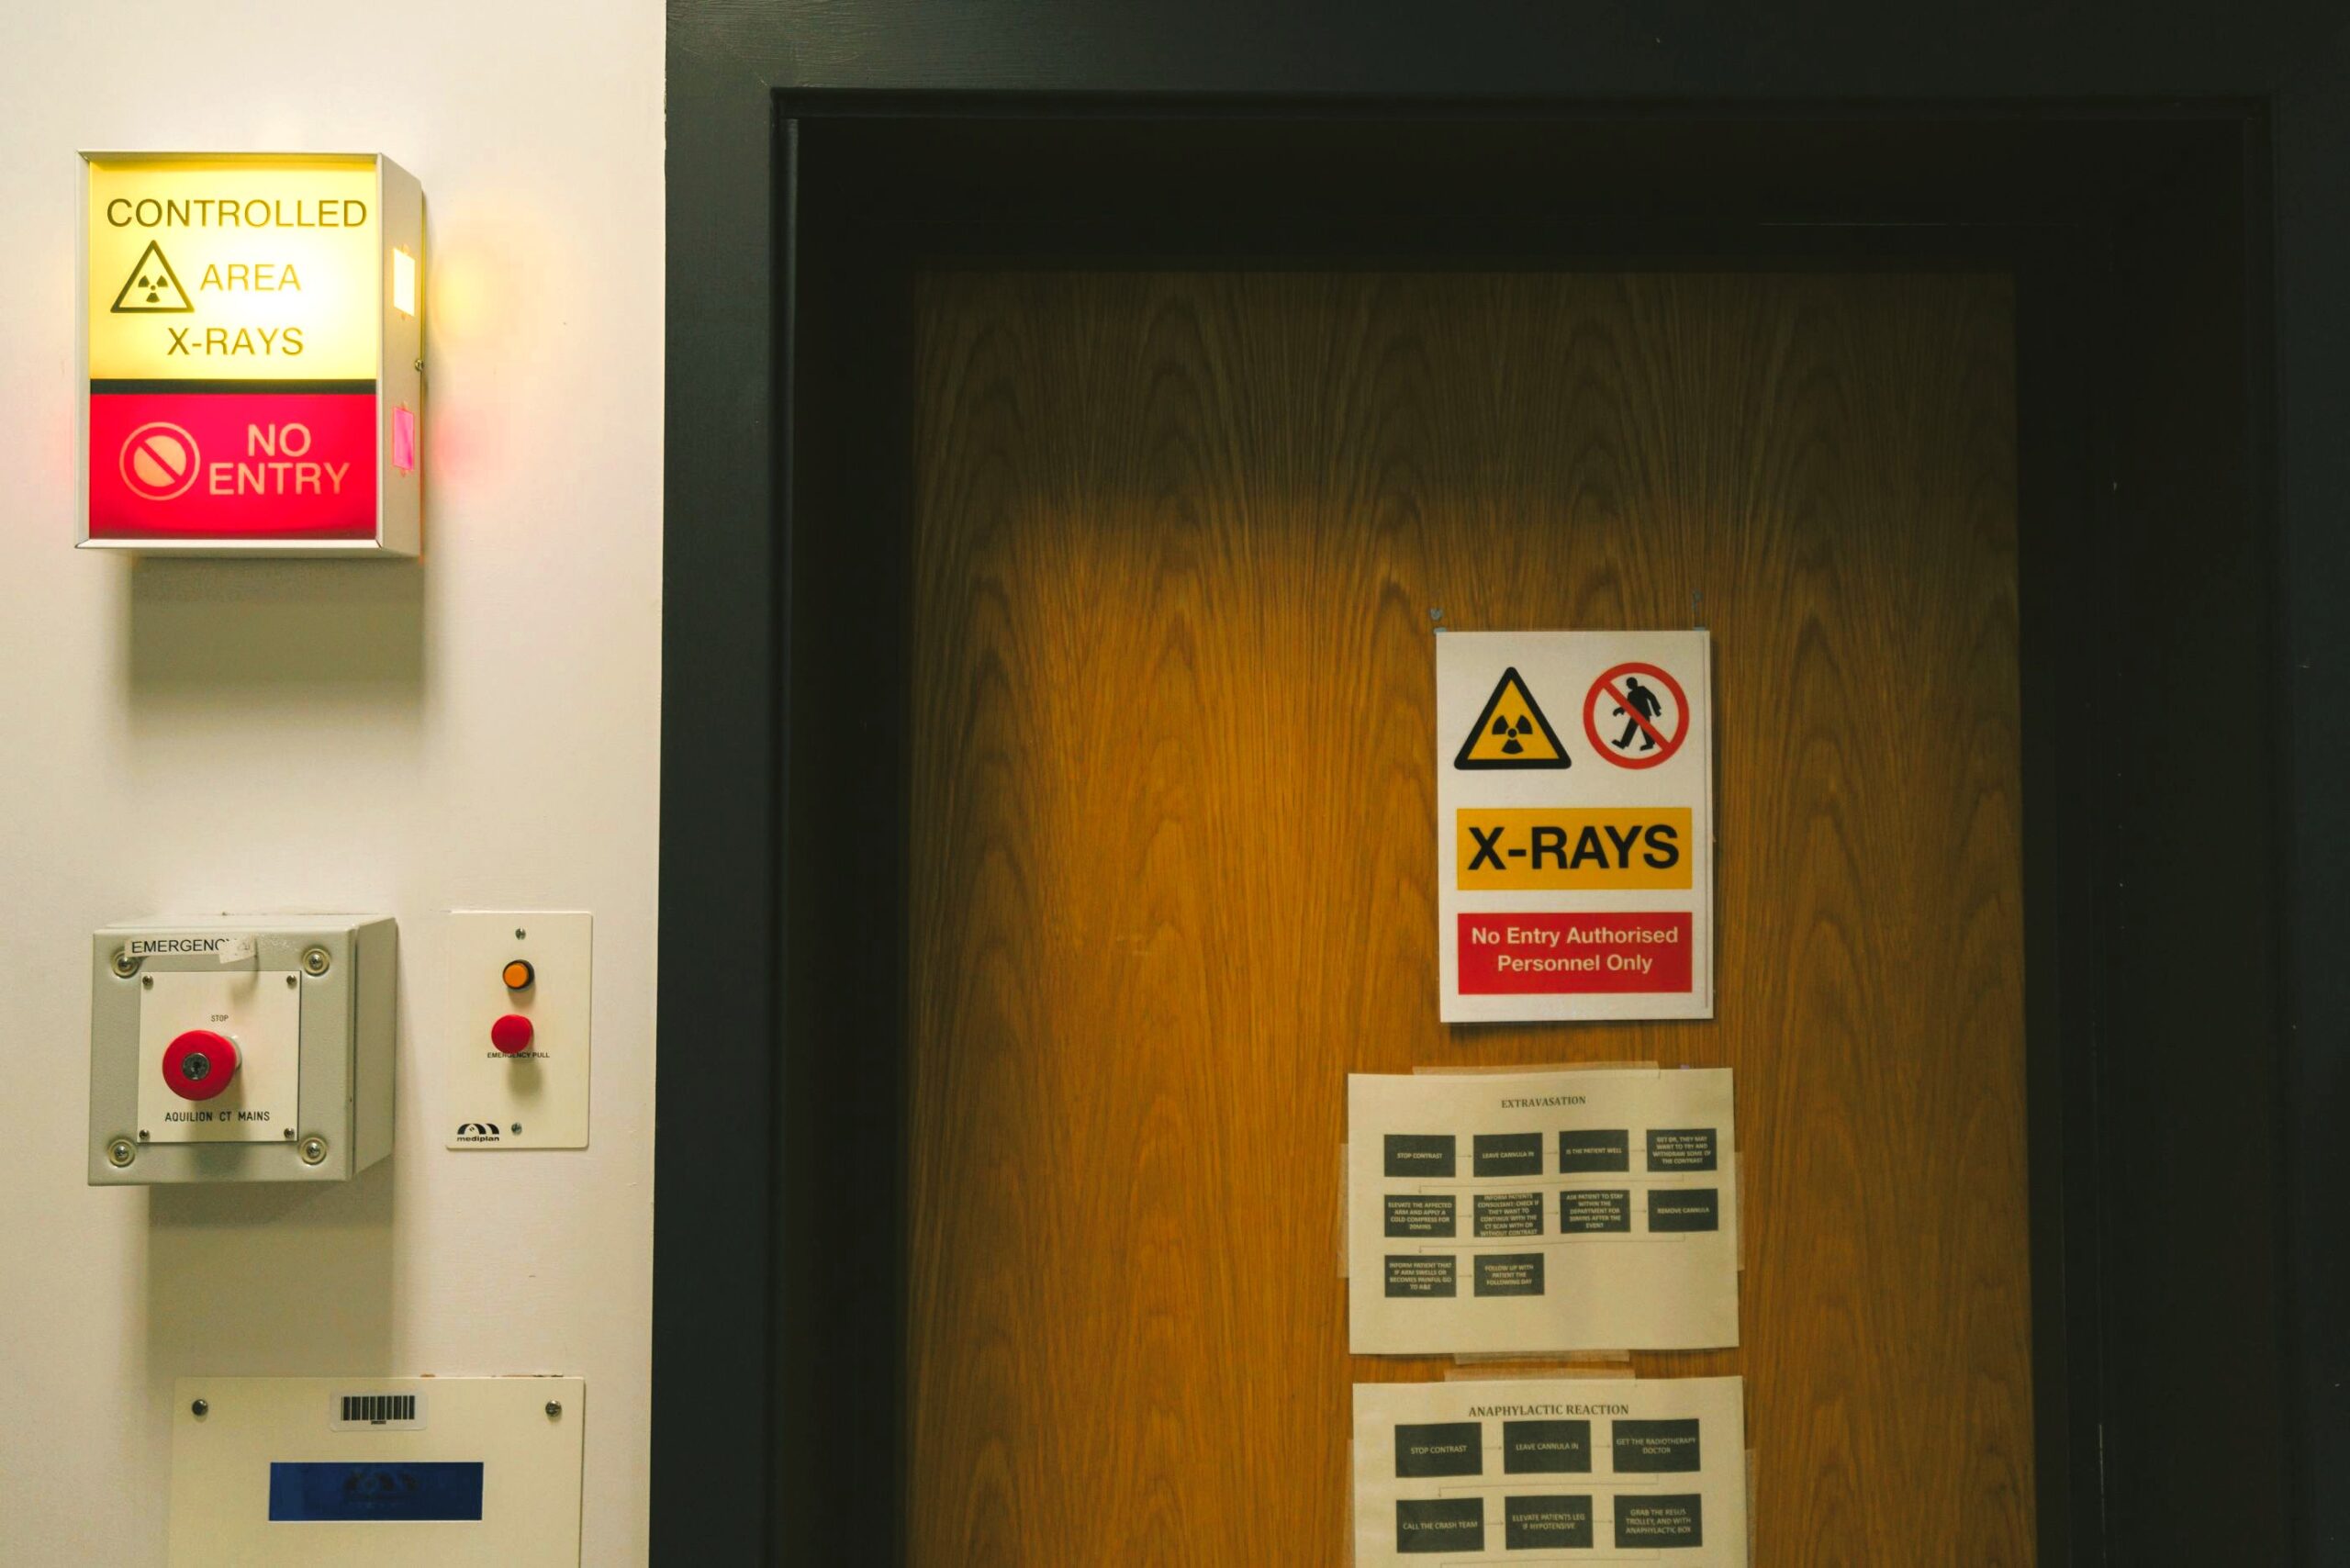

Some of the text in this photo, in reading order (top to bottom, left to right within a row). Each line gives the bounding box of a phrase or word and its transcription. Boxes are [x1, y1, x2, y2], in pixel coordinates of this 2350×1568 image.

[106, 198, 367, 228] CONTROLLED
[200, 263, 301, 291] AREA
[167, 327, 304, 356] X-RAYS
[247, 422, 311, 456] NO
[208, 462, 350, 495] ENTRY
[1468, 824, 1680, 870] X-RAYS
[1472, 926, 1678, 947] No Entry Authorised
[131, 938, 231, 954] EMERGENC
[1497, 954, 1652, 974] Personnel Only
[210, 1014, 229, 1023] STOP
[1501, 1096, 1586, 1108] EXTRAVASATION
[165, 1111, 270, 1122] AQUILION CT MAINS
[1469, 1404, 1628, 1417] ANAPHYLACTIC REACTION
[1516, 1443, 1537, 1451] LEAVE
[1537, 1442, 1570, 1450] CANNULA
[1645, 1437, 1696, 1445] RADIOTHERAPY
[1410, 1445, 1468, 1455] STOP CONTRAST
[1512, 1514, 1539, 1522] ELEVATE
[1629, 1508, 1650, 1517] GRAB
[1403, 1522, 1419, 1530] CALL
[1434, 1521, 1457, 1529] CRASH
[1458, 1520, 1478, 1529] TEAM
[1672, 1517, 1692, 1525] WITH
